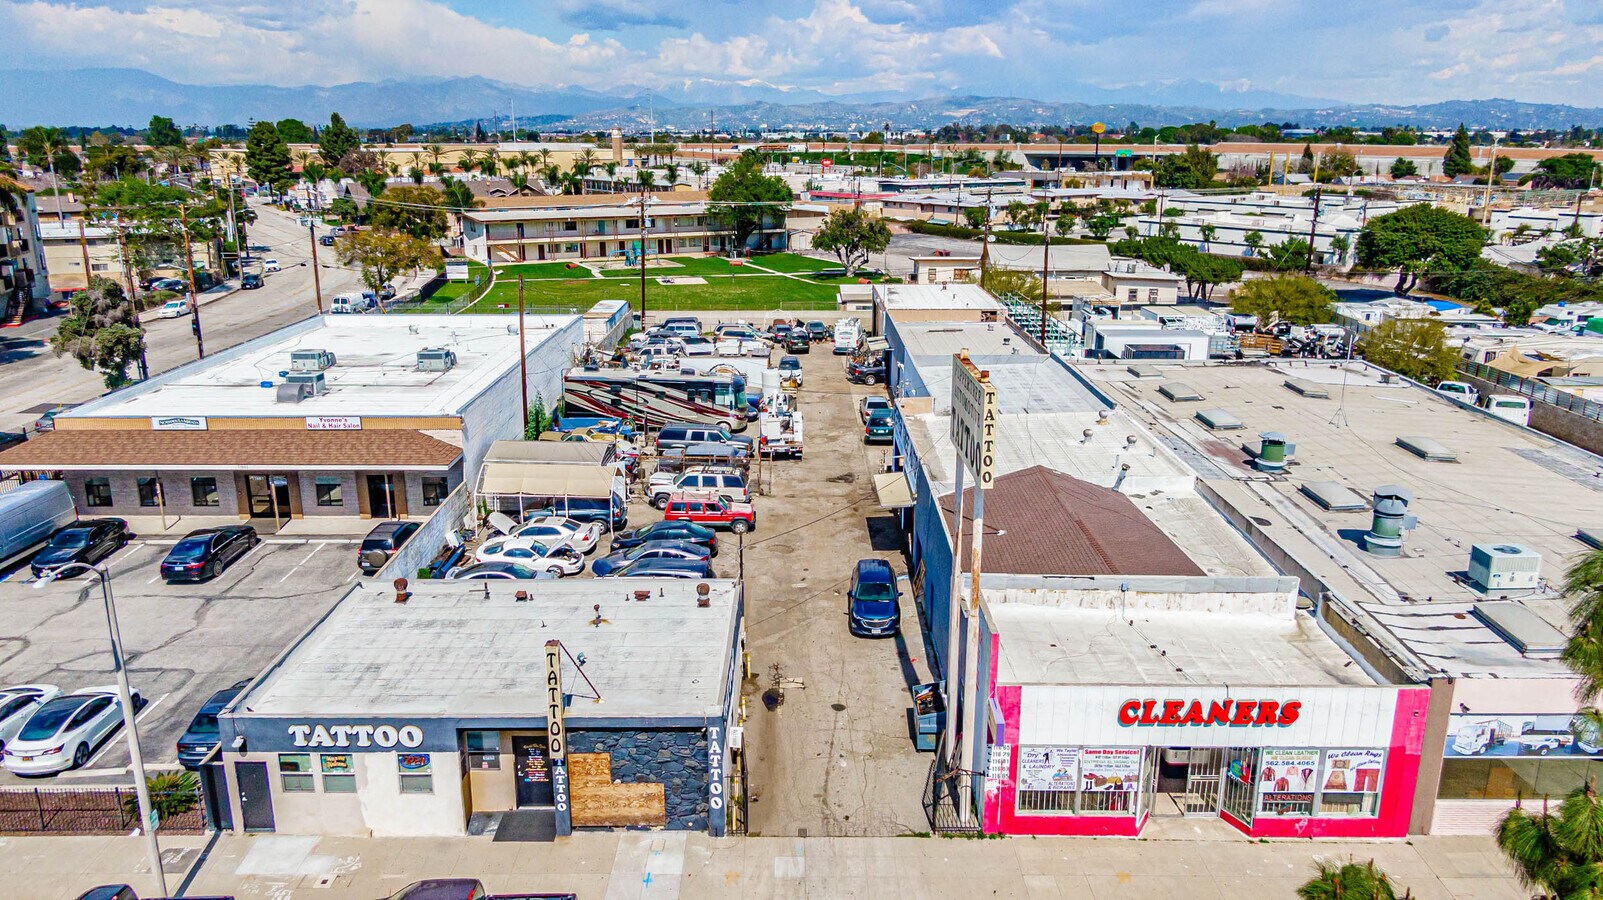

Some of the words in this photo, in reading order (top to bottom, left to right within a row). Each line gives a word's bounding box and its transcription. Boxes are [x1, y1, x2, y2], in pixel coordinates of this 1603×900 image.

[951, 406, 982, 477] TATTOO
[982, 392, 996, 484] TATTOO
[288, 724, 424, 748] TATTOO
[546, 653, 562, 753] TATTOO
[1118, 698, 1302, 728] CLEANERS
[555, 758, 567, 811] TATTOO
[708, 727, 723, 810] TATTOO
